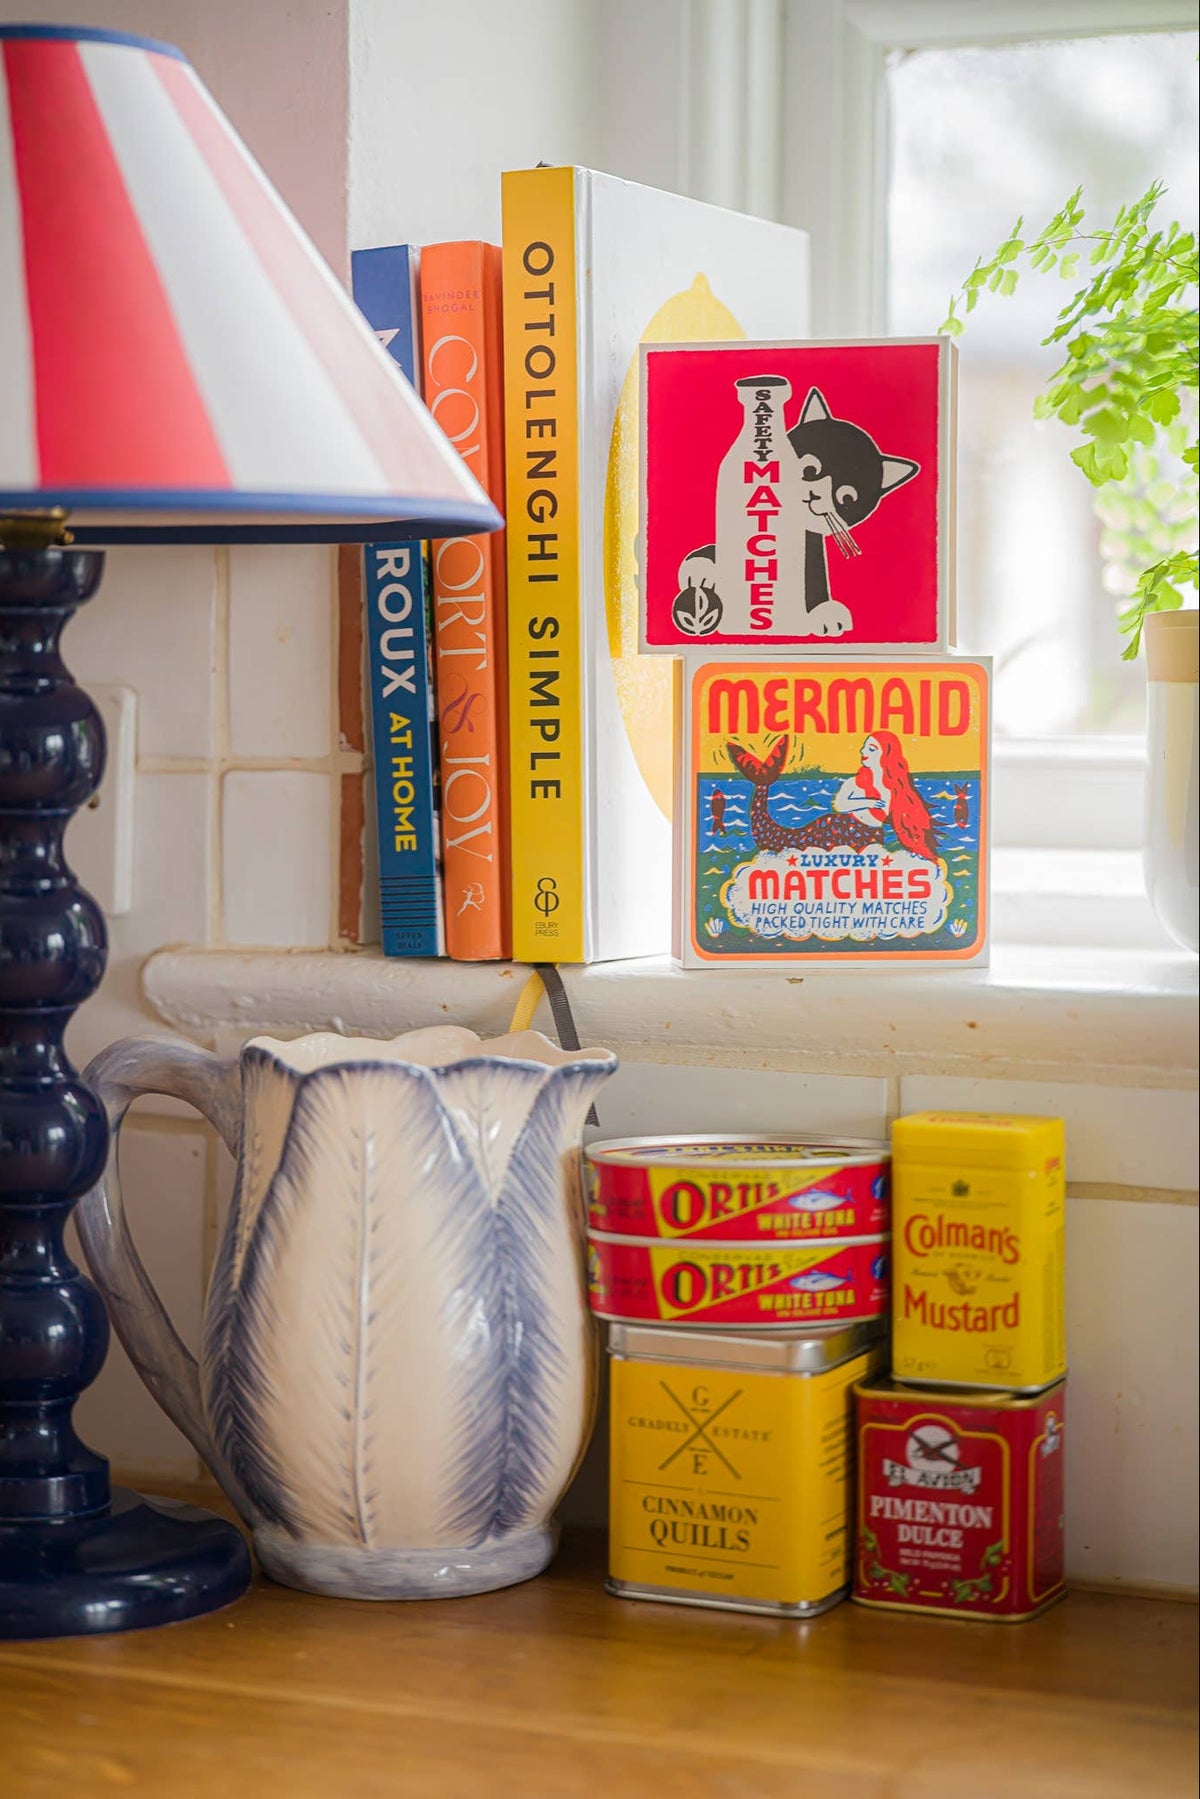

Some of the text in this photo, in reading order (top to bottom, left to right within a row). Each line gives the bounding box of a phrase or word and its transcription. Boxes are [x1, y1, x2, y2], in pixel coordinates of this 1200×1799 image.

[429, 334, 487, 672] COORT
[743, 389, 783, 630] SAFETY MATCHES
[523, 241, 561, 799] OTTOLENGHI SIMPLE
[376, 548, 418, 853] ROUX AT HOME
[708, 677, 972, 737] MERMAID
[442, 741, 493, 862] JOY
[800, 854, 879, 867] LUXURY
[748, 869, 932, 900] MATCHES
[752, 901, 928, 916] HIGH QUALITY MATCHES
[755, 915, 925, 930] PACKED TIGHT WITH CARE
[535, 921, 559, 929] EBURY
[535, 929, 559, 937] PRESS
[757, 1212, 812, 1231] WHITE
[814, 1208, 855, 1227] TUNA
[904, 1213, 1020, 1265] Colman's
[757, 1293, 813, 1311] WHITE
[814, 1288, 855, 1307] TUNA
[904, 1284, 1020, 1333] Mustard
[642, 1495, 759, 1524] CINNAMON
[870, 1495, 994, 1529] PIMENTON
[650, 1518, 751, 1553] QUILLS
[897, 1523, 964, 1549] DULCE
